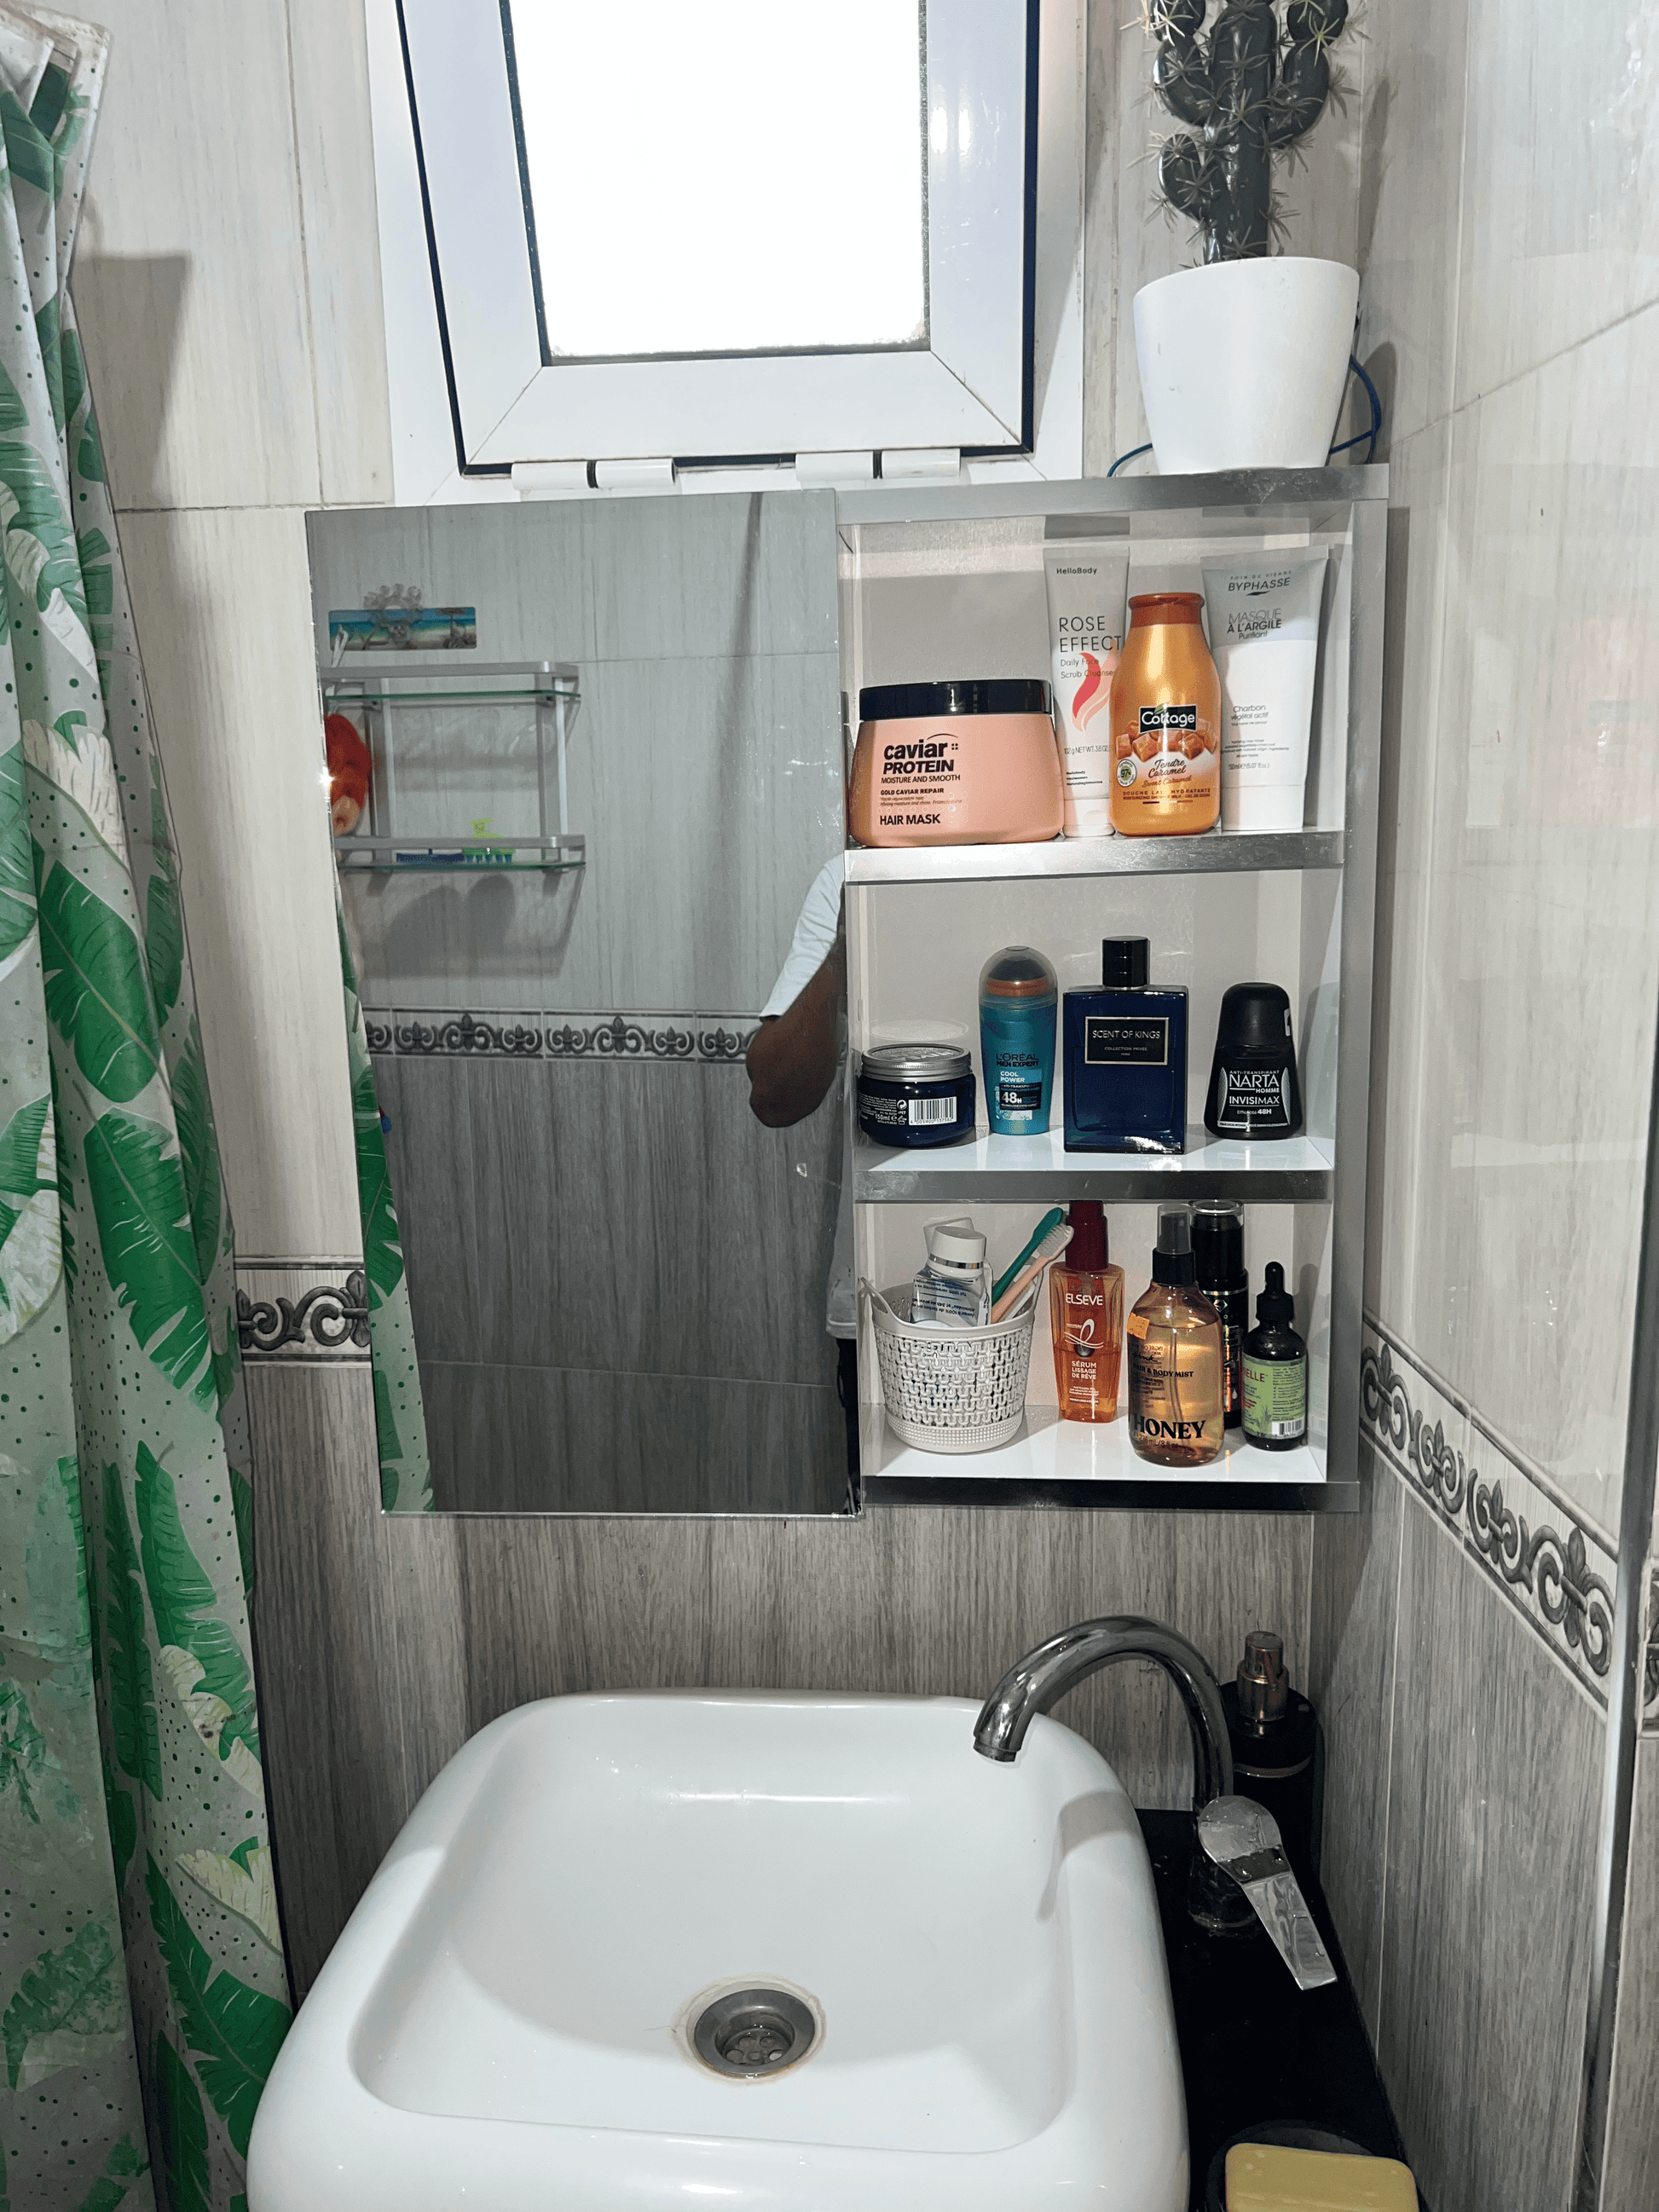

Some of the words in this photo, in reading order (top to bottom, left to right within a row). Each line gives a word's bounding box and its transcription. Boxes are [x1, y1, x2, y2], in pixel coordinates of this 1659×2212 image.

[1228, 577, 1291, 592] BYPHASSE
[1228, 608, 1282, 625] MASQUE
[1059, 615, 1106, 632] ROSE
[1238, 619, 1282, 632] L'ARGILE
[1060, 635, 1122, 653] EFFECT
[1061, 658, 1079, 667] Daily
[1061, 669, 1083, 679] Scrub
[1233, 704, 1266, 713] Charbon
[1142, 711, 1195, 728] Cottage
[884, 739, 948, 760] caviar
[883, 759, 954, 775] PROTEIN
[1154, 758, 1185, 770] Tendre
[1148, 765, 1186, 778] Caramel
[928, 774, 961, 783] SMOOTH
[880, 815, 904, 825] HAIR
[906, 814, 941, 825] MASK
[1092, 1030, 1120, 1038] SCENT
[1121, 1030, 1134, 1038] OF
[1135, 1031, 1160, 1039] KINGS
[1229, 1074, 1280, 1088] NARTA
[1002, 1091, 1022, 1104] 48H
[1229, 1095, 1280, 1105] INVISIMAX
[1066, 1293, 1103, 1306] ELSEVE
[1072, 1360, 1096, 1368] SÉRUM
[1081, 1372, 1096, 1380] RÊVE
[1153, 1369, 1173, 1377] BODY
[1134, 1414, 1206, 1440] HONEY
